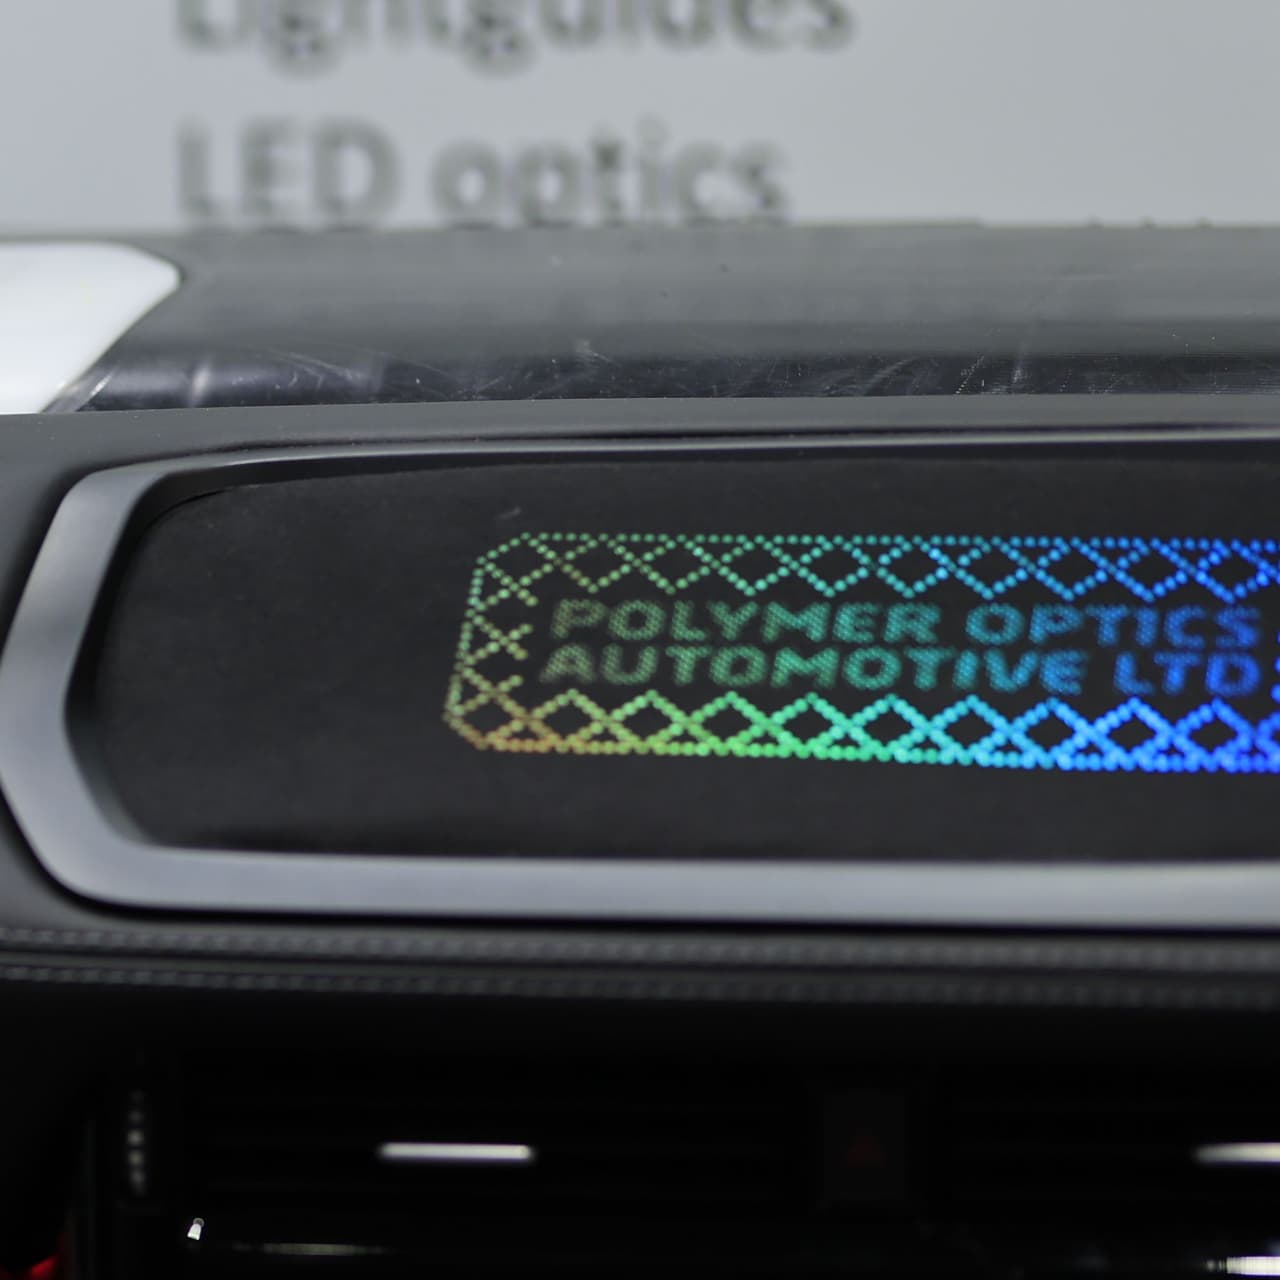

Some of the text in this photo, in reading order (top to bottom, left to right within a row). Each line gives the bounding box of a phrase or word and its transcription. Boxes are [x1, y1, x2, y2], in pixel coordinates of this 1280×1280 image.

[176, 114, 790, 227] LED optics
[550, 599, 1262, 649] POLYMER OPTICS
[540, 644, 1263, 695] AUTOMOTIVE LTD
